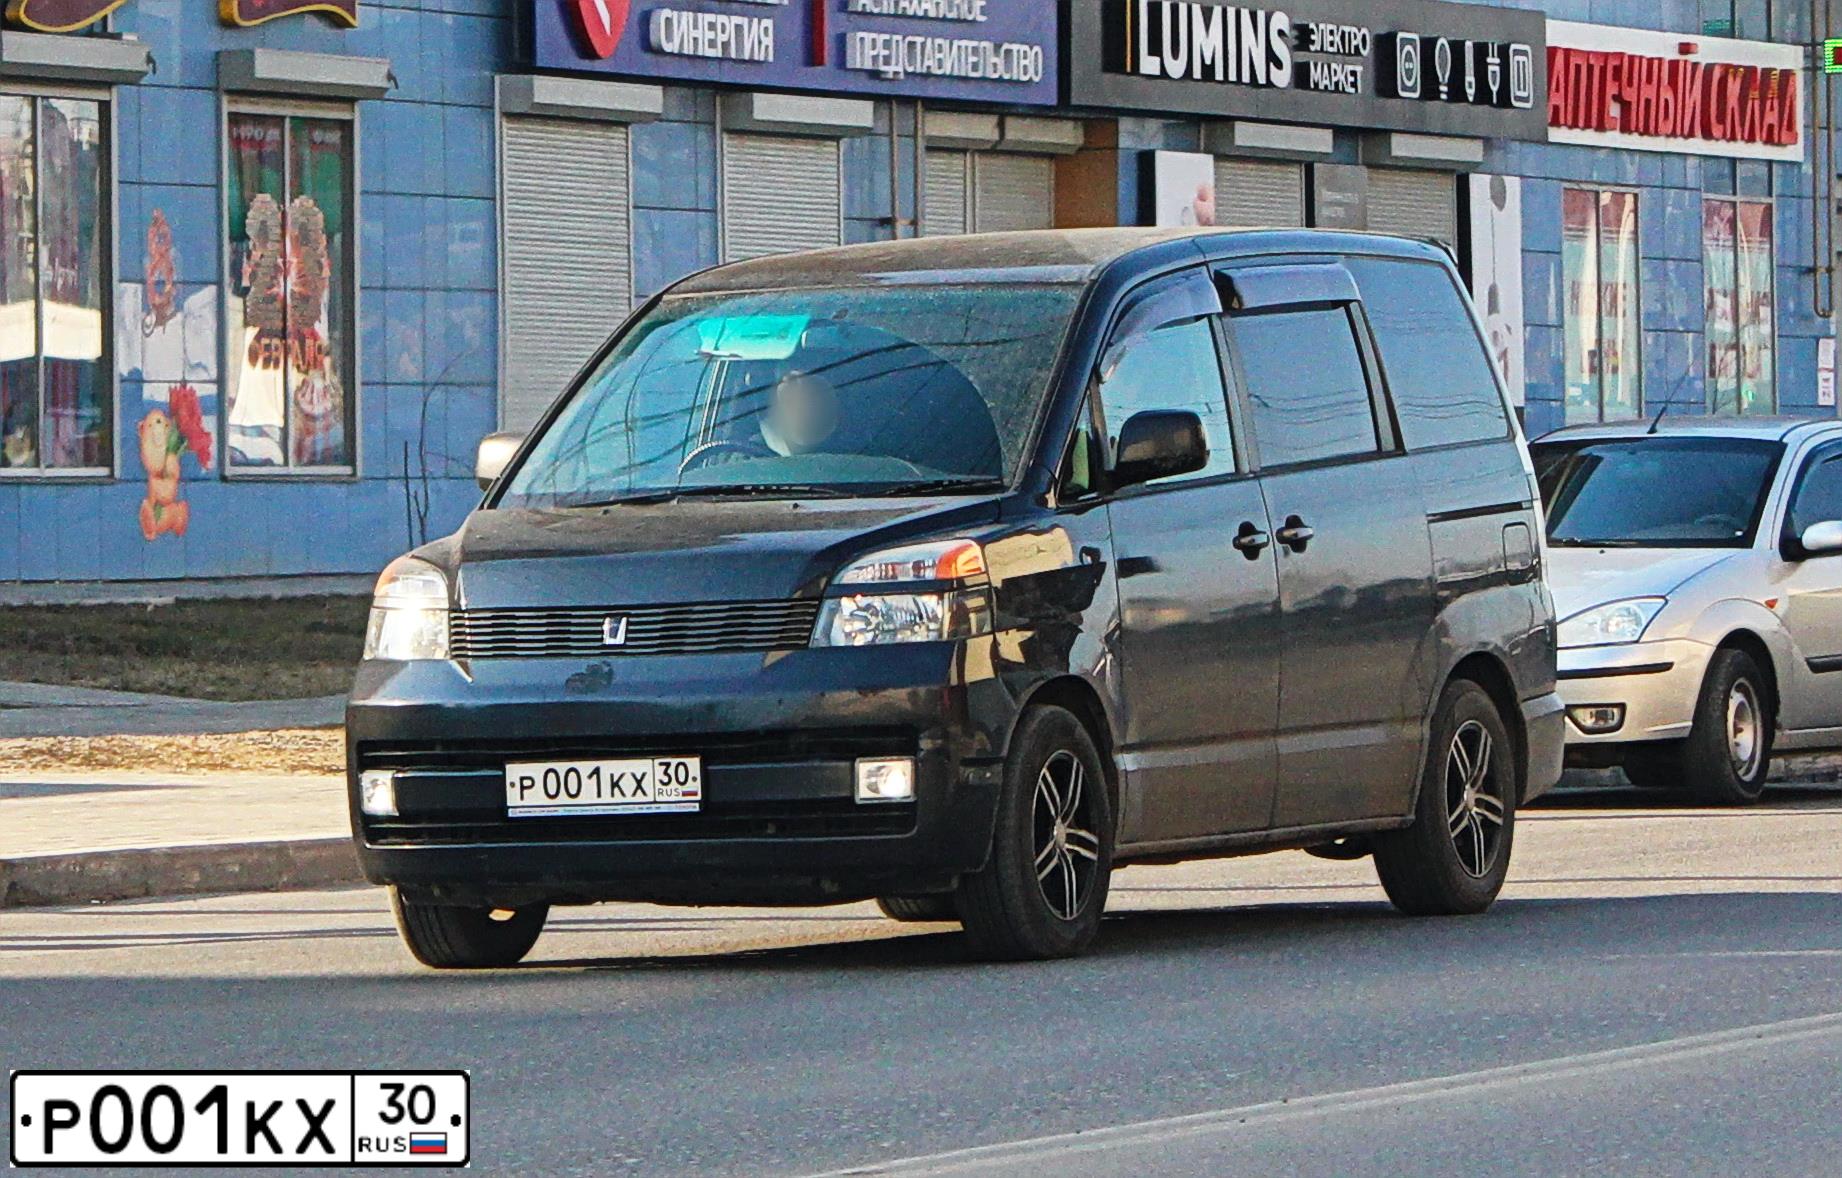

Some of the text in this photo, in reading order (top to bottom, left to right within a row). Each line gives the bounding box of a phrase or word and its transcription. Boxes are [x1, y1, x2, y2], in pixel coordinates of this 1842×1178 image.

[659, 8, 774, 62] СИНЕРГИЯ
[1139, 0, 1292, 88] LUMINS
[1308, 22, 1370, 56] ЭЛЕКТРО
[855, 31, 1044, 82] ПРЕДСТАВИТЕЛЬСТВО
[1308, 61, 1364, 94] МАРКЕТ
[1547, 42, 1798, 144] АПТЕЧНЫЙ СКЛАД
[657, 761, 690, 786] 30
[657, 787, 681, 797] RUS
